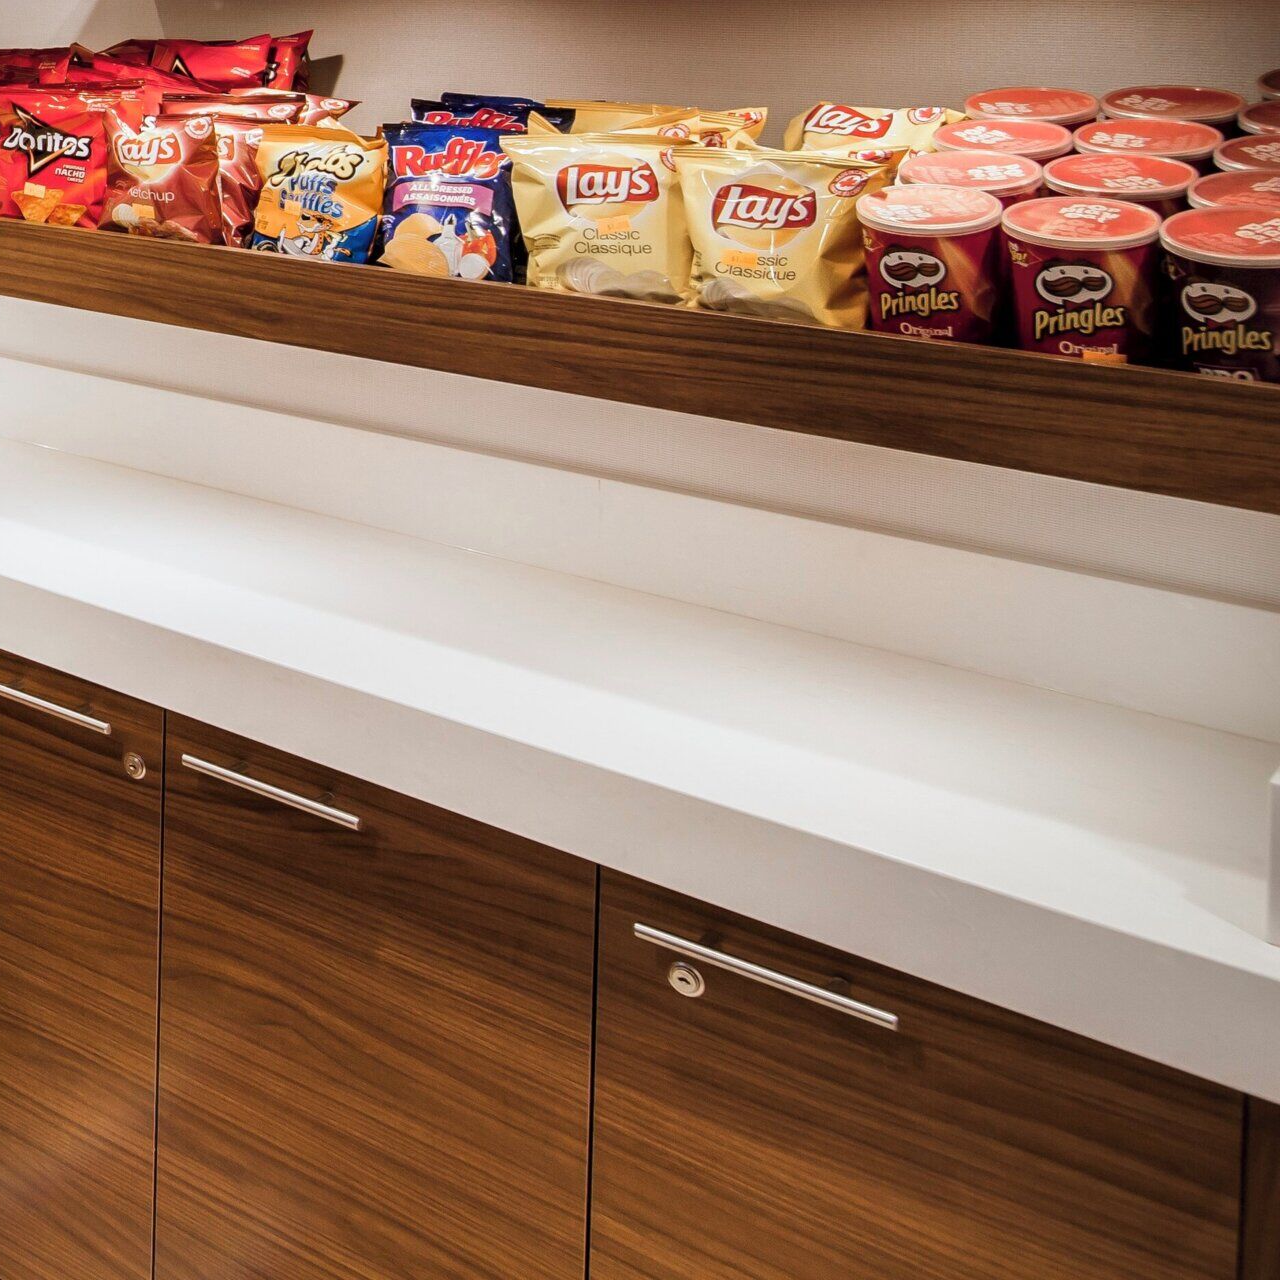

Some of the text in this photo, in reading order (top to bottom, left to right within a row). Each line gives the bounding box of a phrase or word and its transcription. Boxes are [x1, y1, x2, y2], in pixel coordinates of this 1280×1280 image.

[805, 104, 891, 137] Lay's
[3, 126, 91, 158] Doritos
[392, 136, 510, 180] Ruffles
[54, 168, 86, 179] NACHO
[290, 175, 338, 195] Puffs
[409, 182, 474, 196] ALL DRESSED
[566, 162, 652, 205] Lay's
[402, 193, 476, 206] ASSAISONNÉES
[717, 185, 814, 230] Lay's
[573, 241, 653, 257] Classique
[582, 227, 640, 241] Classic
[880, 286, 960, 320] Pringles
[899, 321, 954, 339] Original
[1034, 302, 1125, 340] Pringles
[1181, 323, 1272, 356] Pringles
